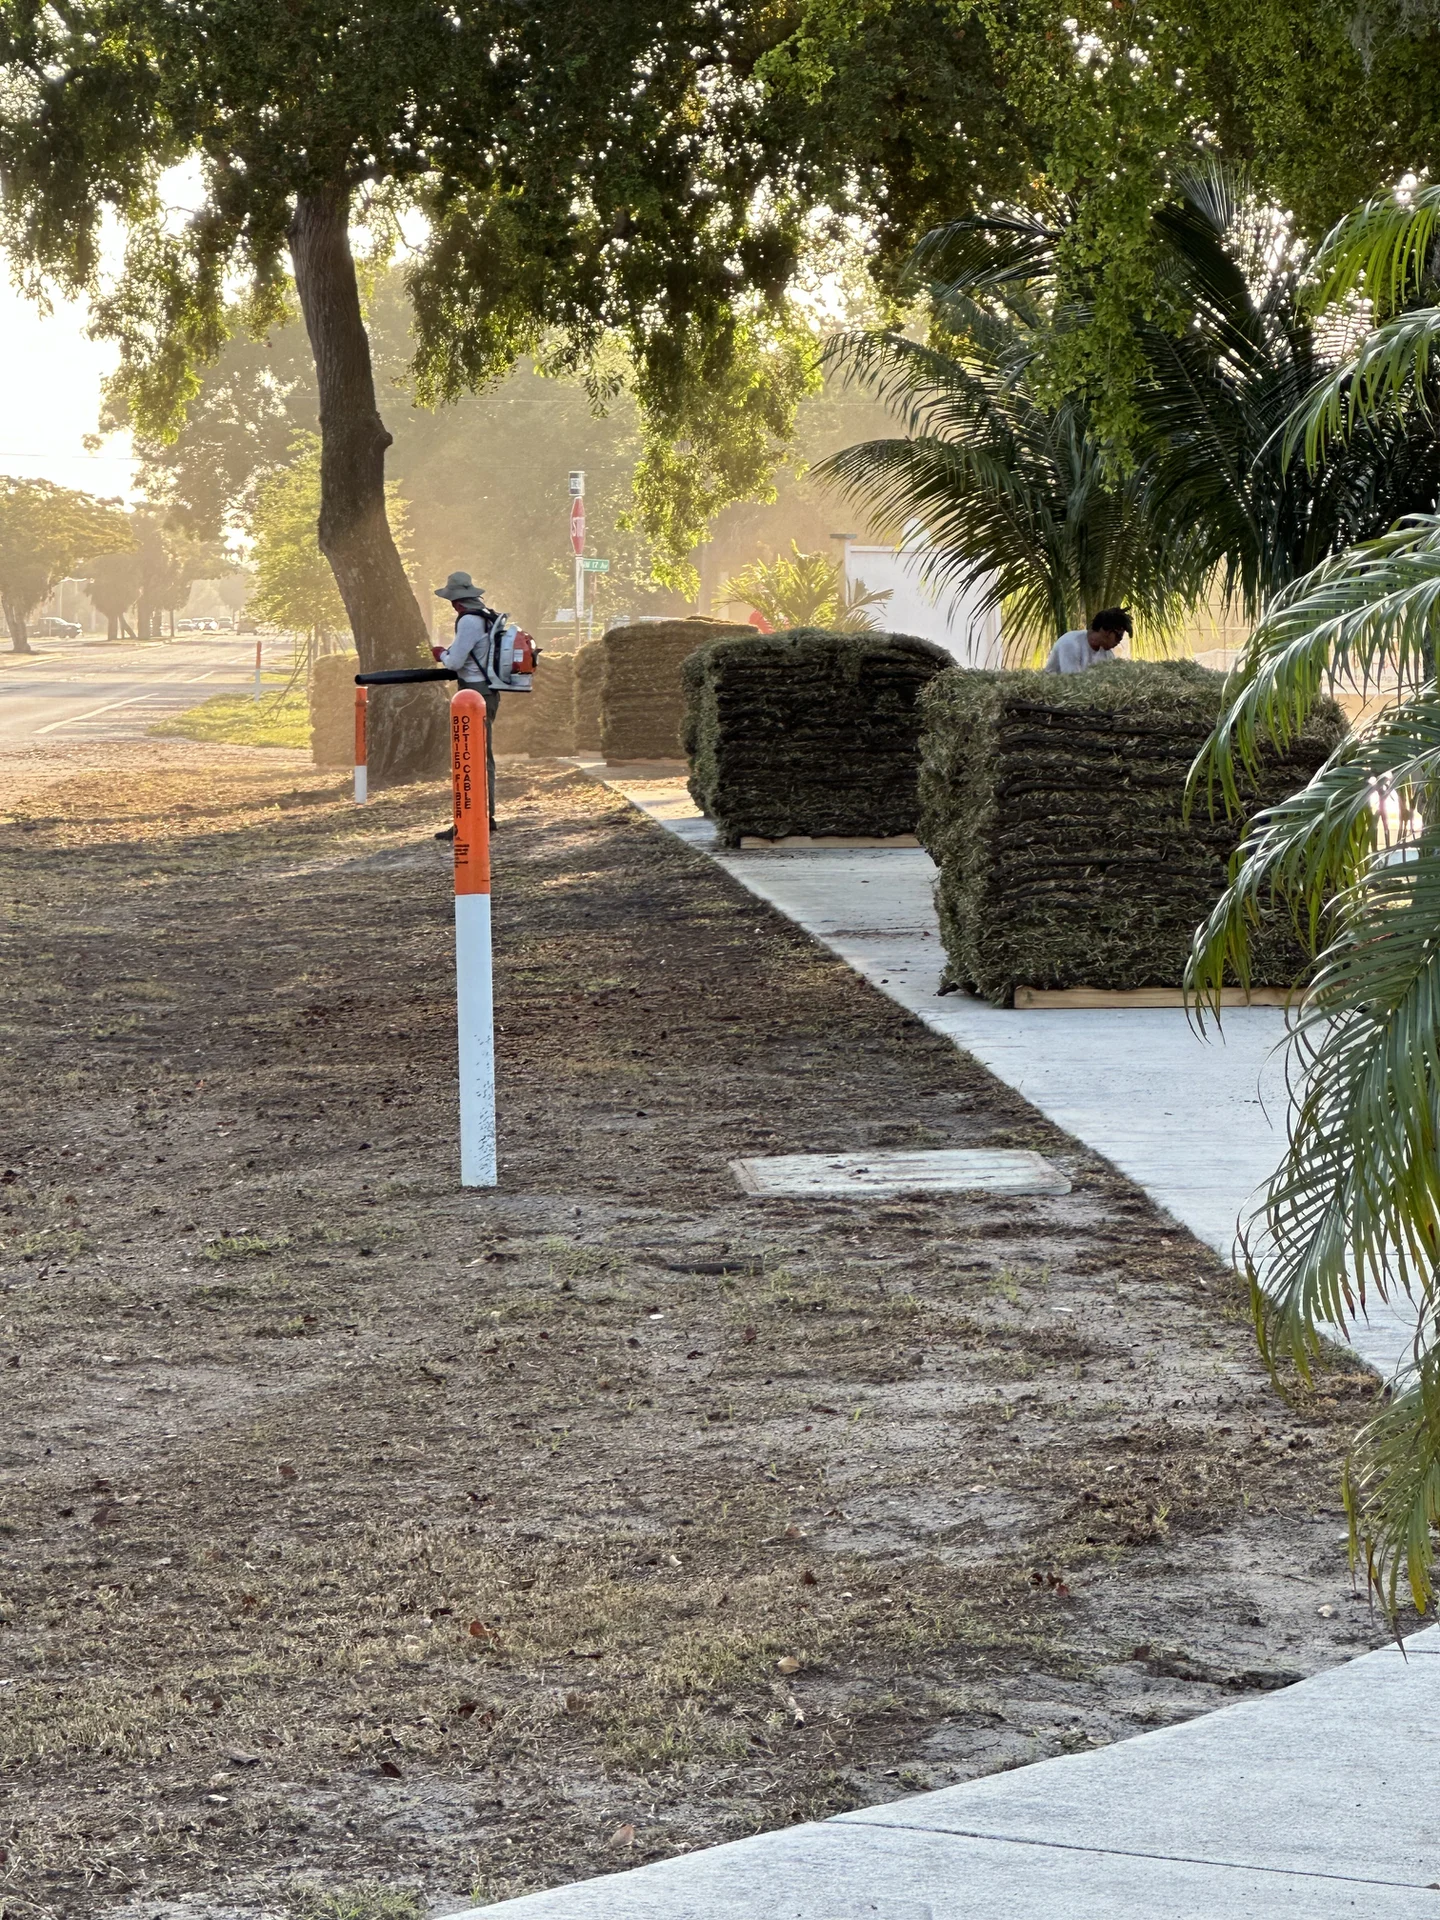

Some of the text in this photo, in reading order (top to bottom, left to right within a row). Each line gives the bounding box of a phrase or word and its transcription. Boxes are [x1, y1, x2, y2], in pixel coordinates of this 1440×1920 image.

[453, 715, 461, 770] BURIED
[461, 715, 472, 810] OPTIC CABLE
